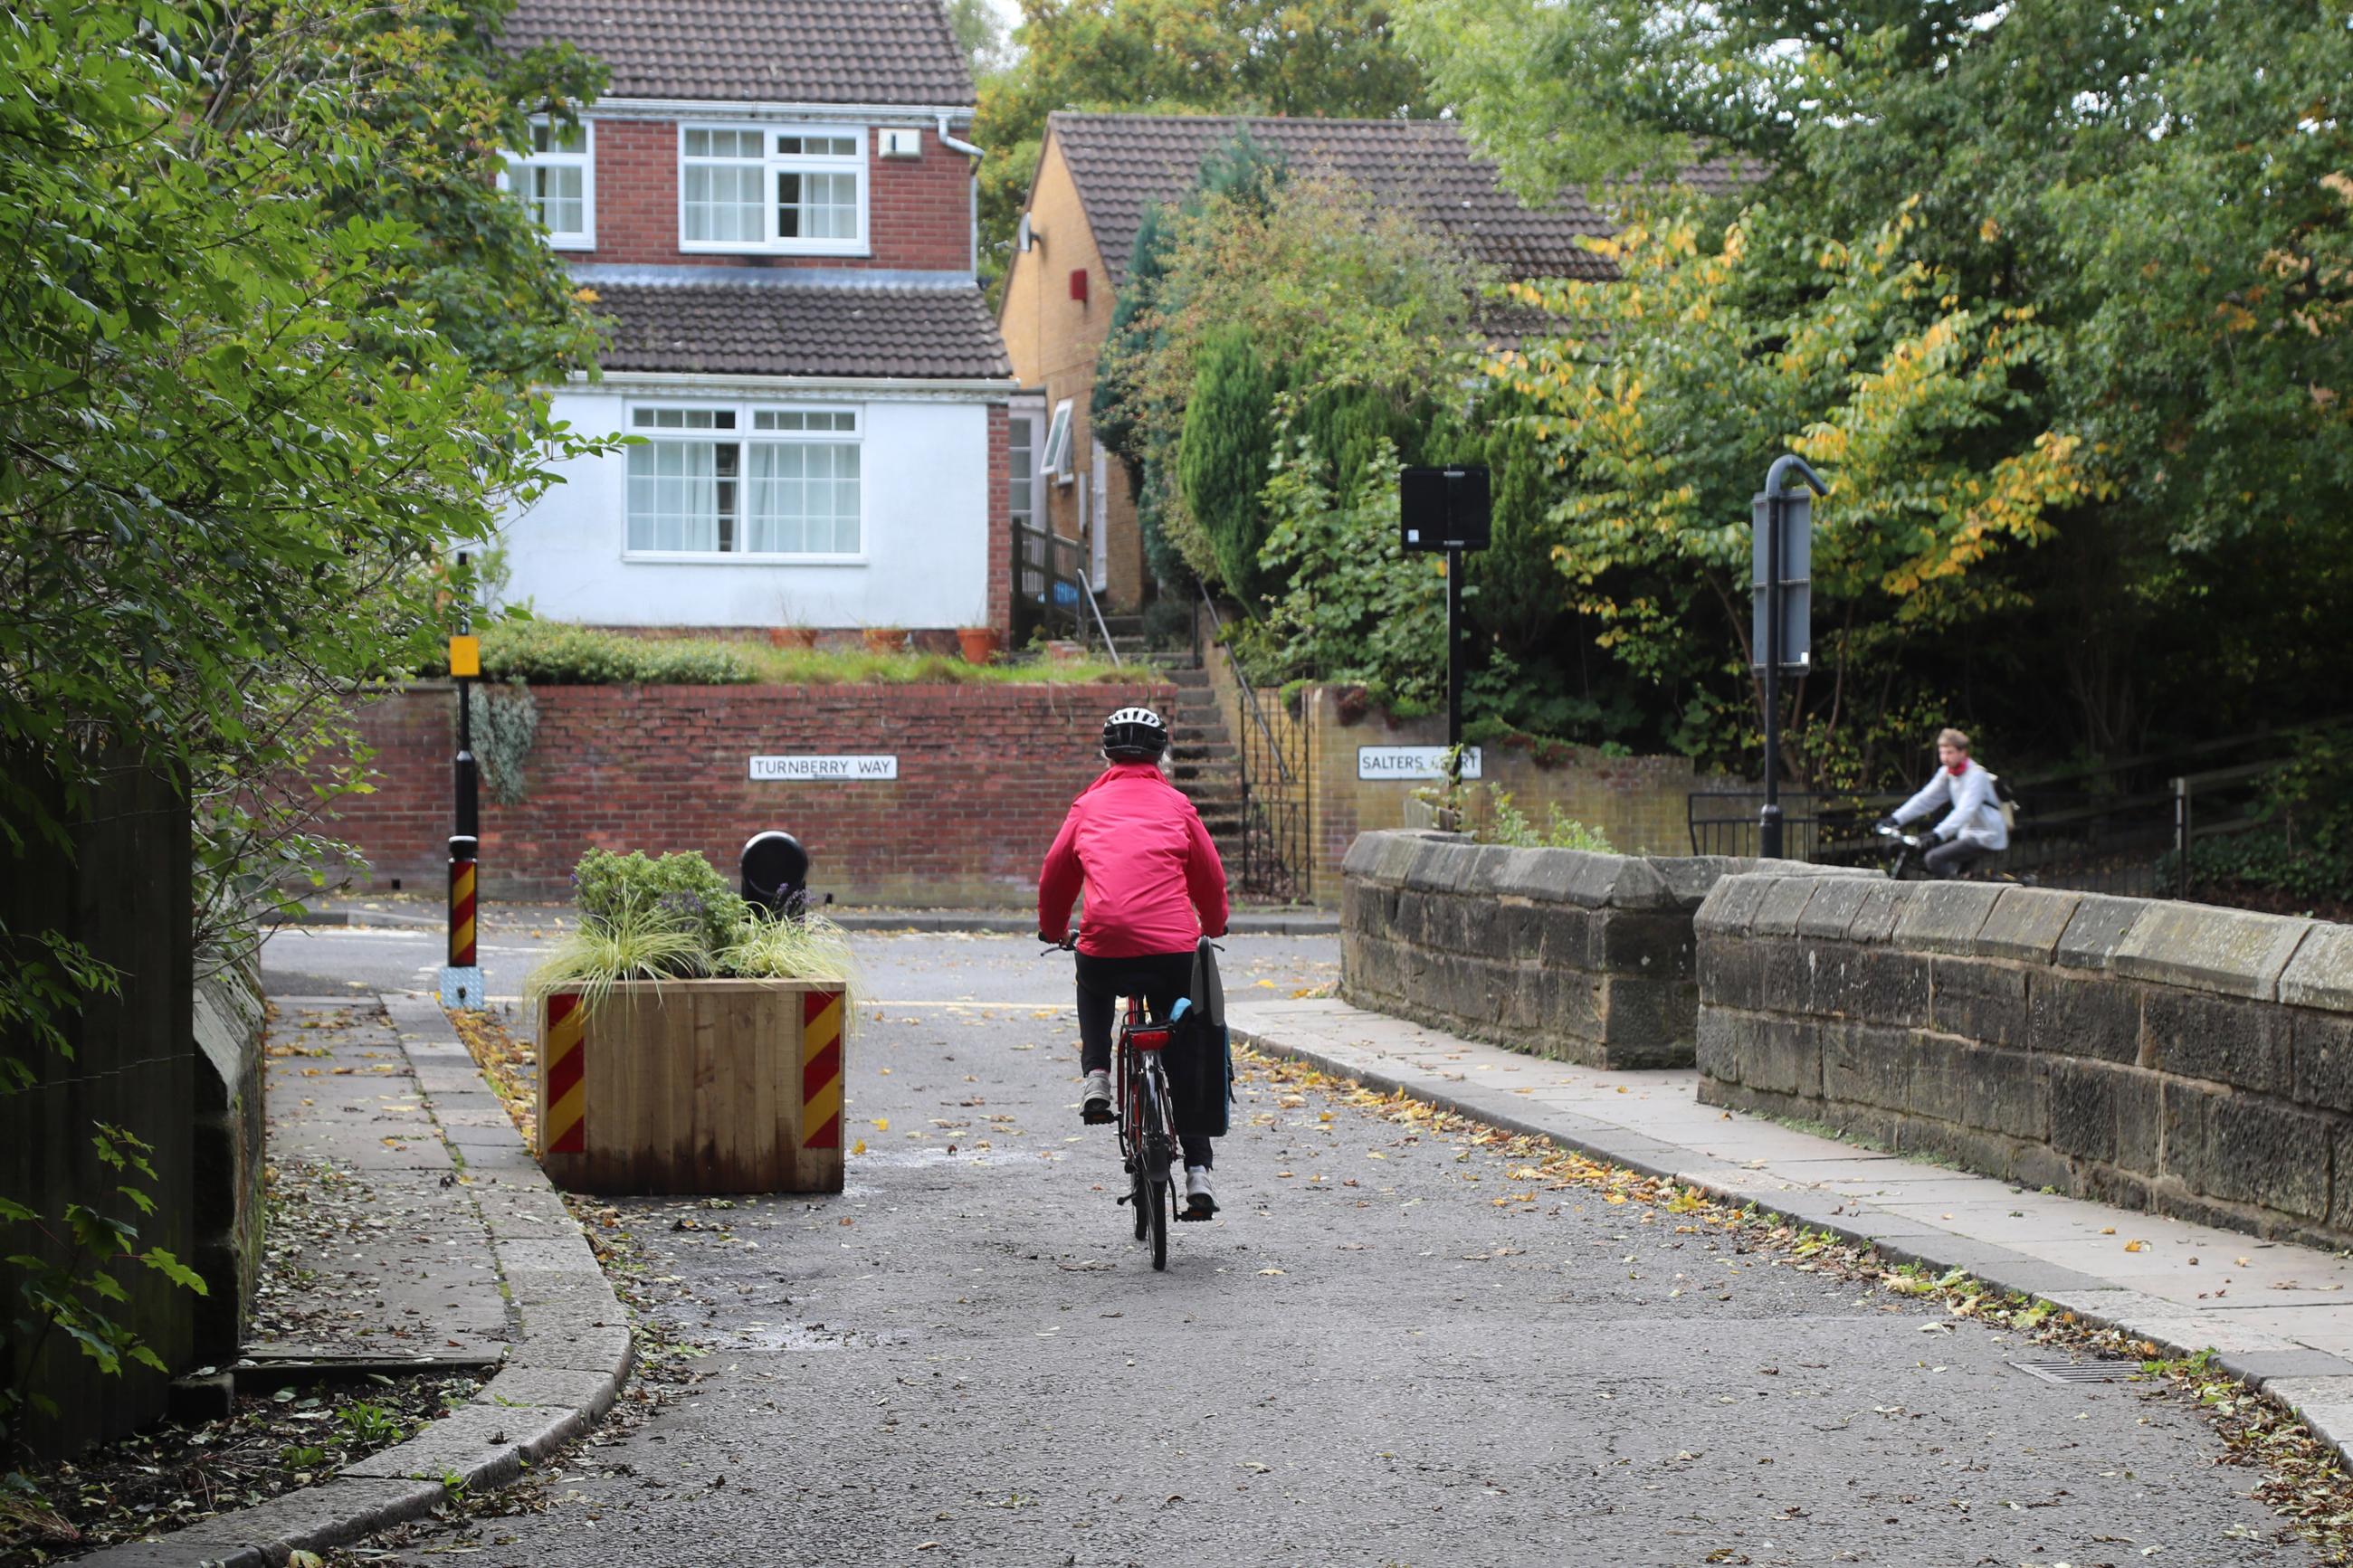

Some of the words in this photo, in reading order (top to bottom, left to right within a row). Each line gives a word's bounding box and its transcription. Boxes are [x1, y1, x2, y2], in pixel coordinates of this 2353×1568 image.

[755, 760, 848, 774] TURNBERRY
[858, 760, 891, 774] WAY
[1362, 756, 1423, 769] SALTERS
